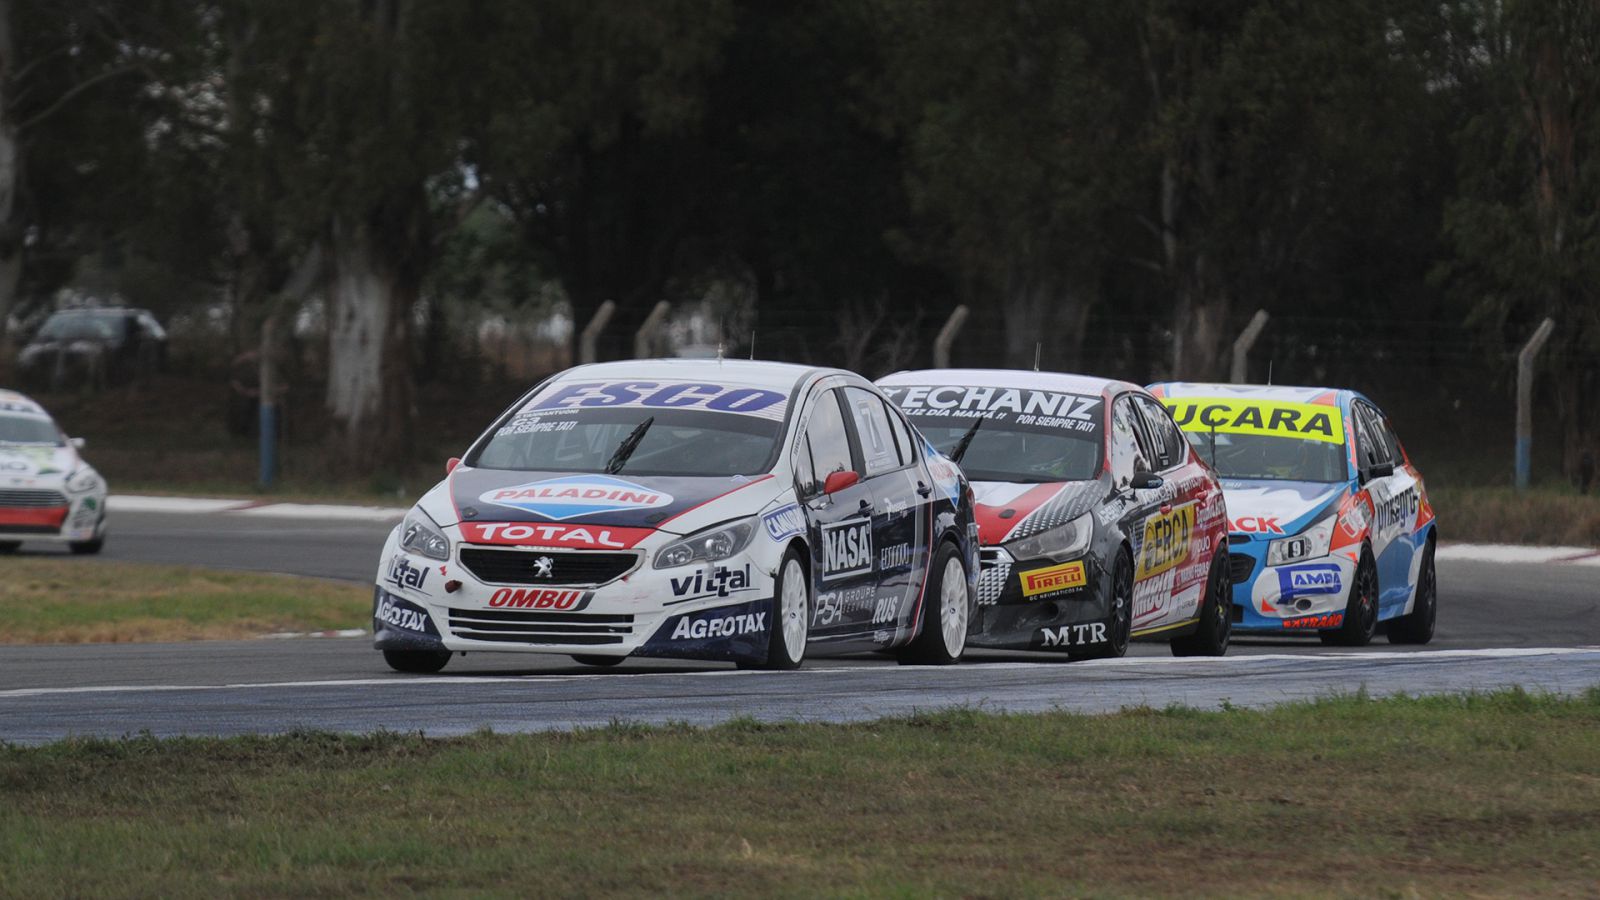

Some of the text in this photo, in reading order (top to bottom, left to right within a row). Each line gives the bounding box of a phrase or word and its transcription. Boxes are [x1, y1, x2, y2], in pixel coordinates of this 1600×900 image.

[529, 381, 787, 411] ESCO
[555, 421, 578, 431] TATI
[1016, 414, 1096, 433] POR SIEMPRE TATI
[1168, 404, 1333, 437] UCARA
[494, 488, 659, 505] PALADINI
[475, 522, 627, 547] TOTAL
[823, 526, 870, 573] NASA
[1027, 566, 1081, 590] PIRELLI
[488, 588, 580, 609] OMBU
[812, 591, 843, 627] PSA
[872, 596, 898, 624] RUS
[671, 612, 766, 640] AGROTAX
[1041, 622, 1107, 646] MTR
